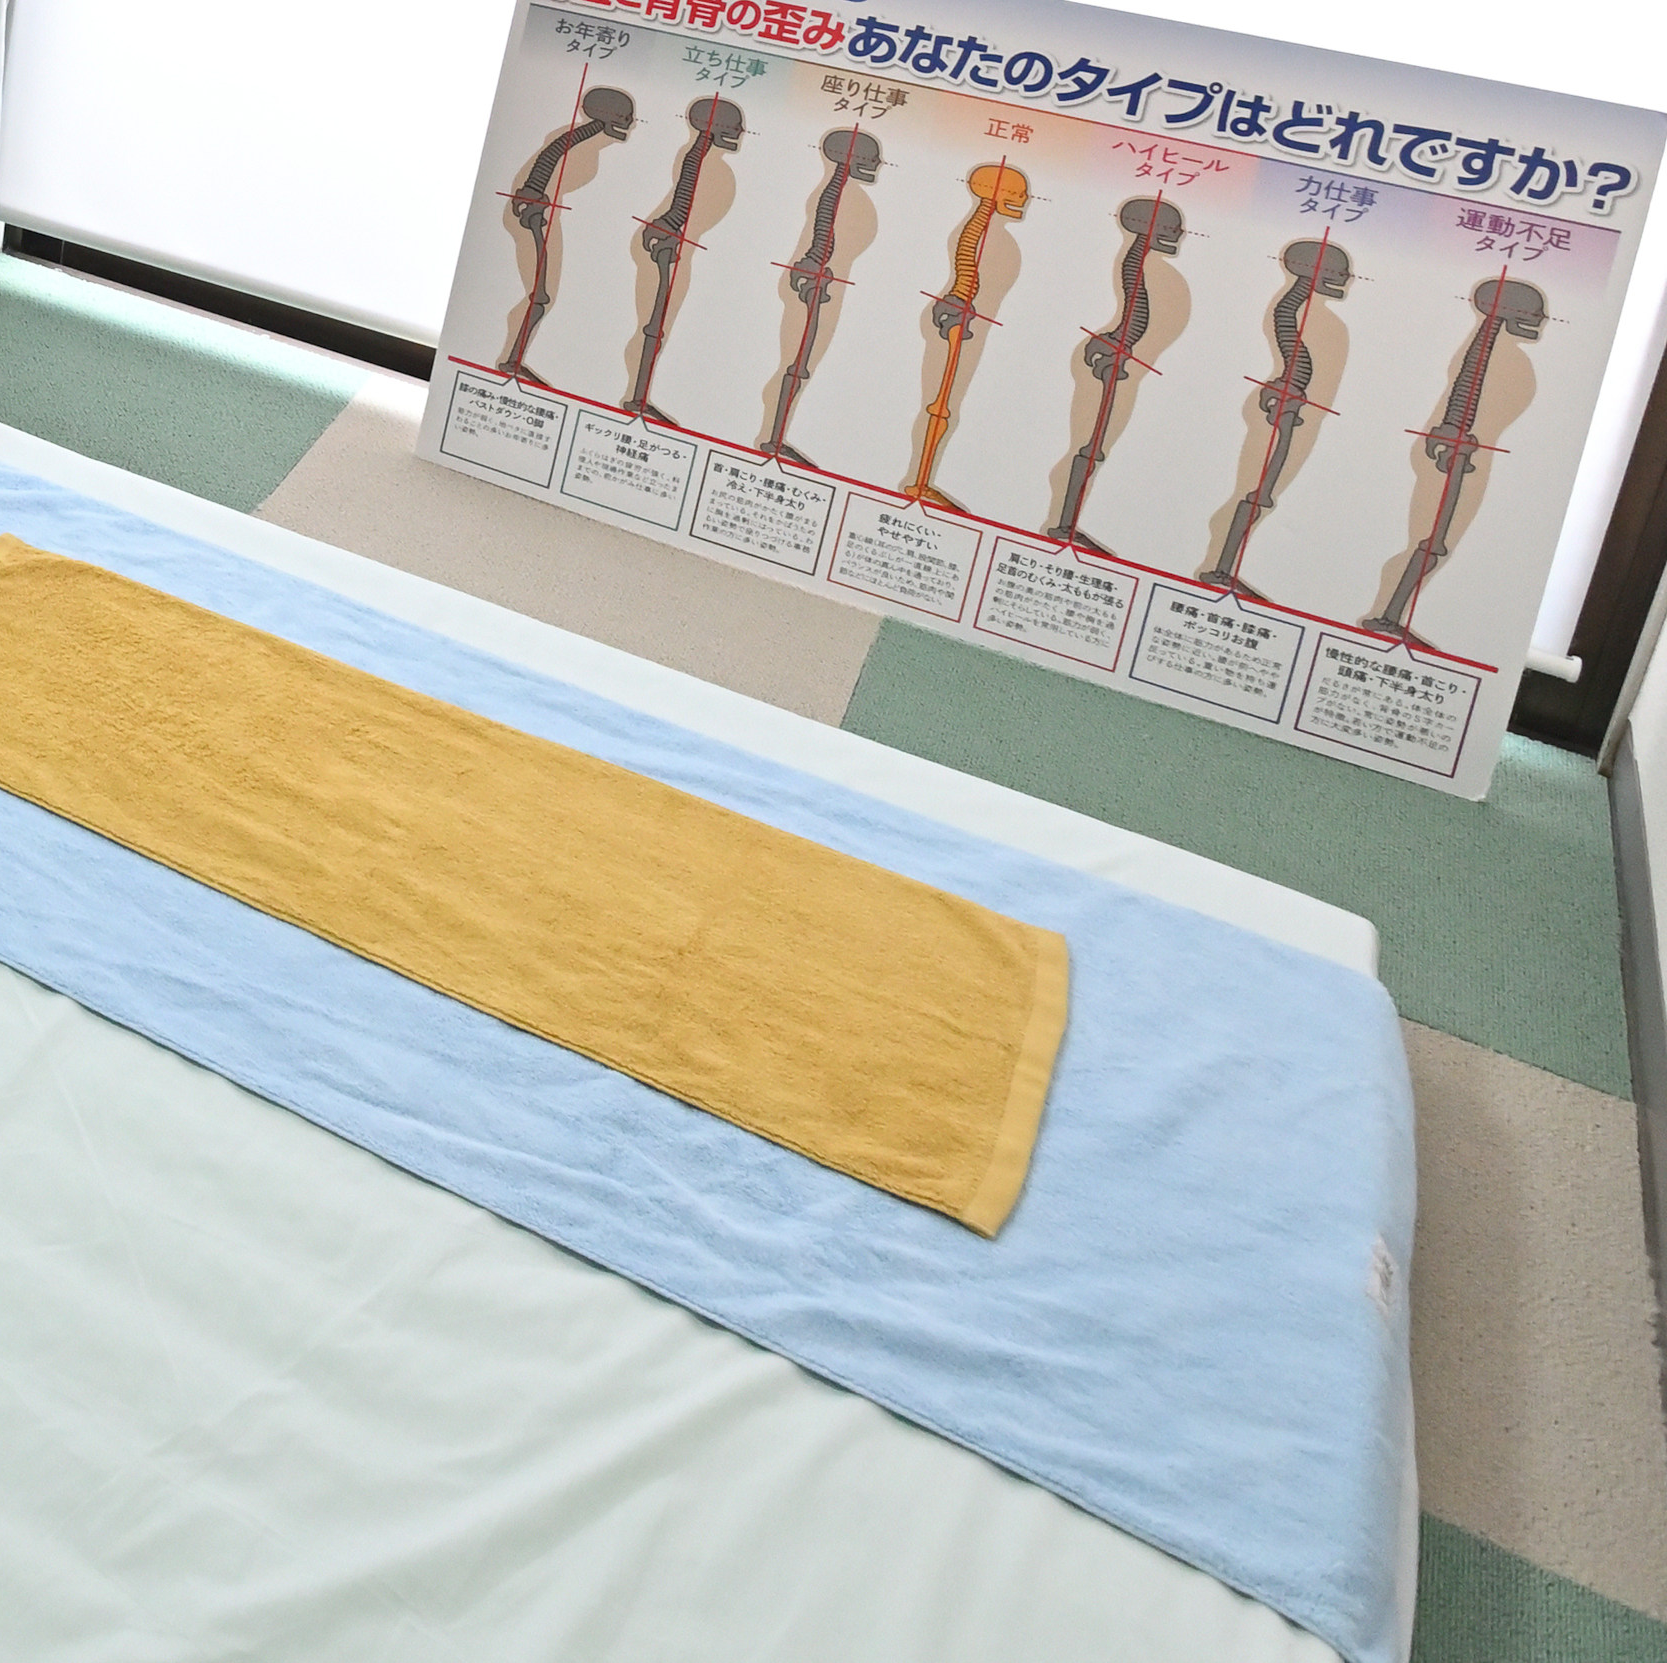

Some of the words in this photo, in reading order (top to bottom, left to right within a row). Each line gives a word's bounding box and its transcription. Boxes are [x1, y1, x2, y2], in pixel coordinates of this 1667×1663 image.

[554, 18, 632, 48] お年寄り
[566, 38, 620, 60] タイプ
[682, 45, 768, 77] 立ち仕事
[695, 66, 752, 89] タイプ
[820, 74, 910, 108] 座り仕事
[833, 98, 893, 120] タイプ
[984, 118, 1034, 144] 正常
[1113, 140, 1230, 173] ハイヒール
[1135, 161, 1201, 187] タイプ
[1295, 175, 1377, 207] 力仕事
[1300, 198, 1369, 223] タイプ
[1455, 207, 1572, 251] 運動不足
[1475, 237, 1549, 262] タイプ
[615, 444, 649, 463] 神経痛
[725, 478, 805, 511] 冷え・下半身太り
[876, 525, 938, 553] やせやすい
[996, 562, 1125, 609] 足首のむくみ・太ももが張る
[1336, 664, 1445, 705] 頭痛・下半身太り
